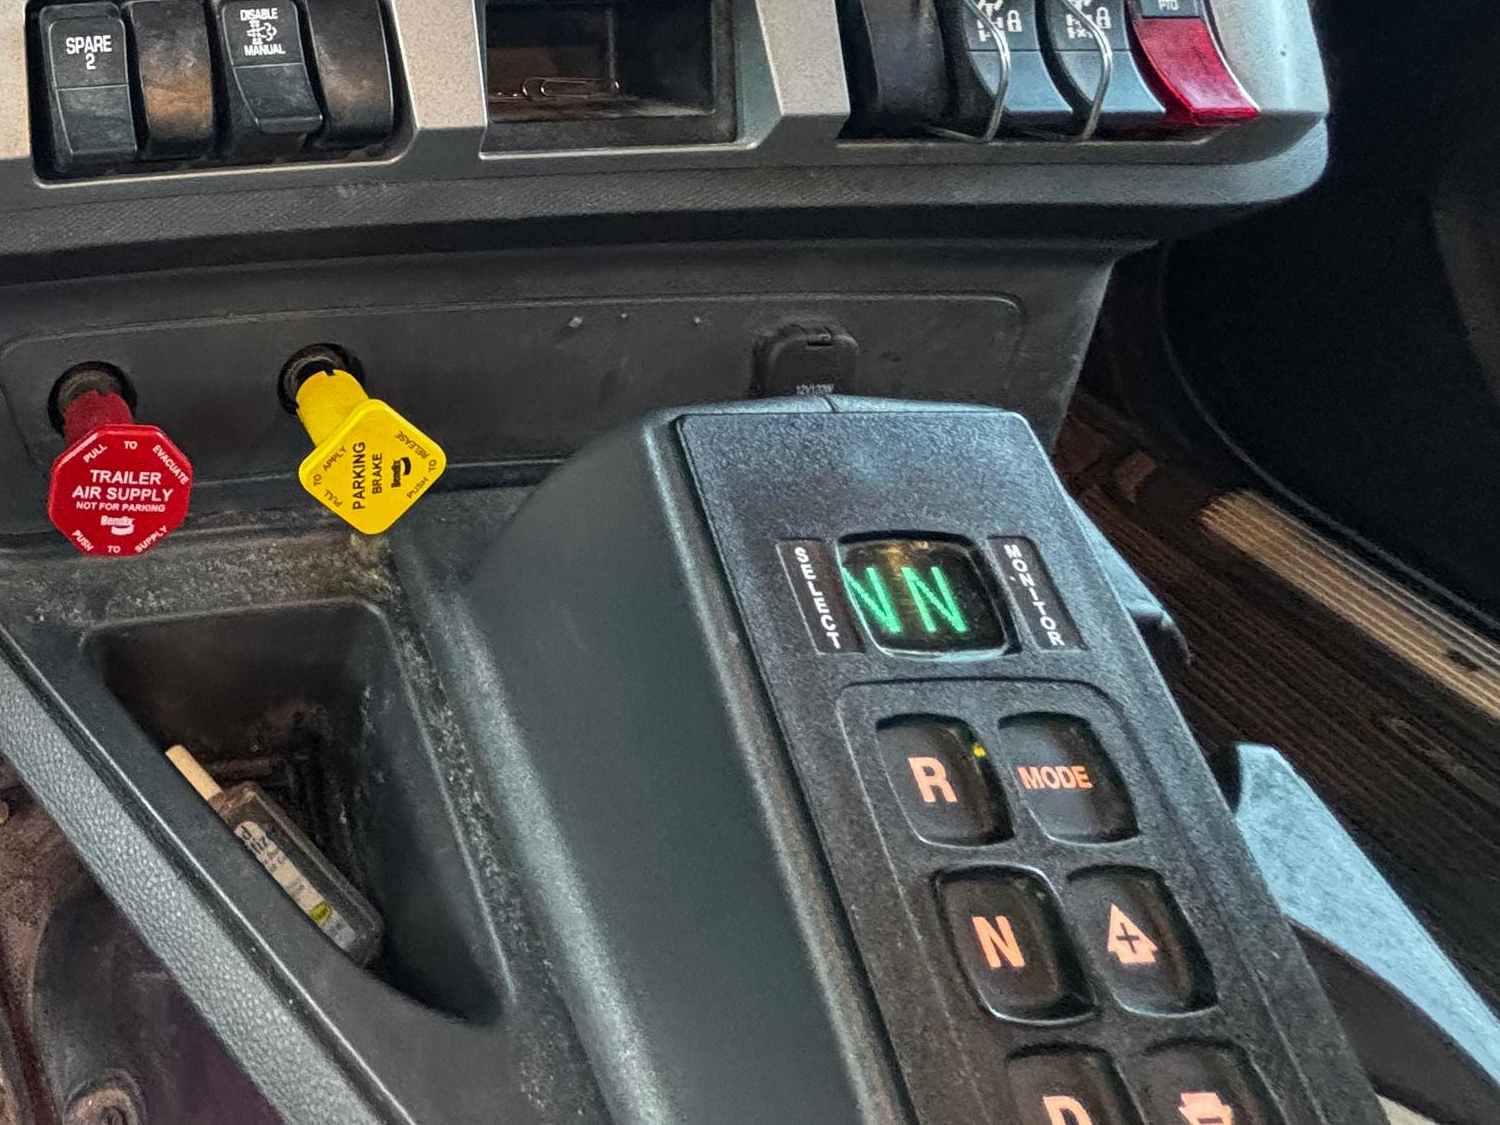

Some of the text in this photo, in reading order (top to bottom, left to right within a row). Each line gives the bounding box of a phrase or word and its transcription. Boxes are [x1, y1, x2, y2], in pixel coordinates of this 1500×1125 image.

[240, 7, 279, 21] DISABLE
[66, 34, 113, 55] SPARE
[86, 53, 97, 71] 2
[244, 43, 286, 57] MANUAL
[83, 440, 190, 485] PULL TO EVACUATE
[90, 469, 162, 485] TRAILER
[313, 473, 323, 487] TO
[322, 445, 347, 472] APPLY
[352, 441, 366, 510] PARKING
[371, 452, 383, 495] BRAKE
[406, 477, 430, 500] PUSH
[428, 458, 438, 473] TO
[71, 485, 174, 503] AIR SUPPLY
[76, 501, 166, 513] NOT FOR PARKING
[72, 525, 169, 554] PUSH TO SUPPLY
[794, 546, 841, 649] SELECT
[1003, 543, 1066, 647] MONITOR
[907, 756, 958, 803] R
[1017, 765, 1094, 790] MODE
[971, 915, 1026, 969] N
